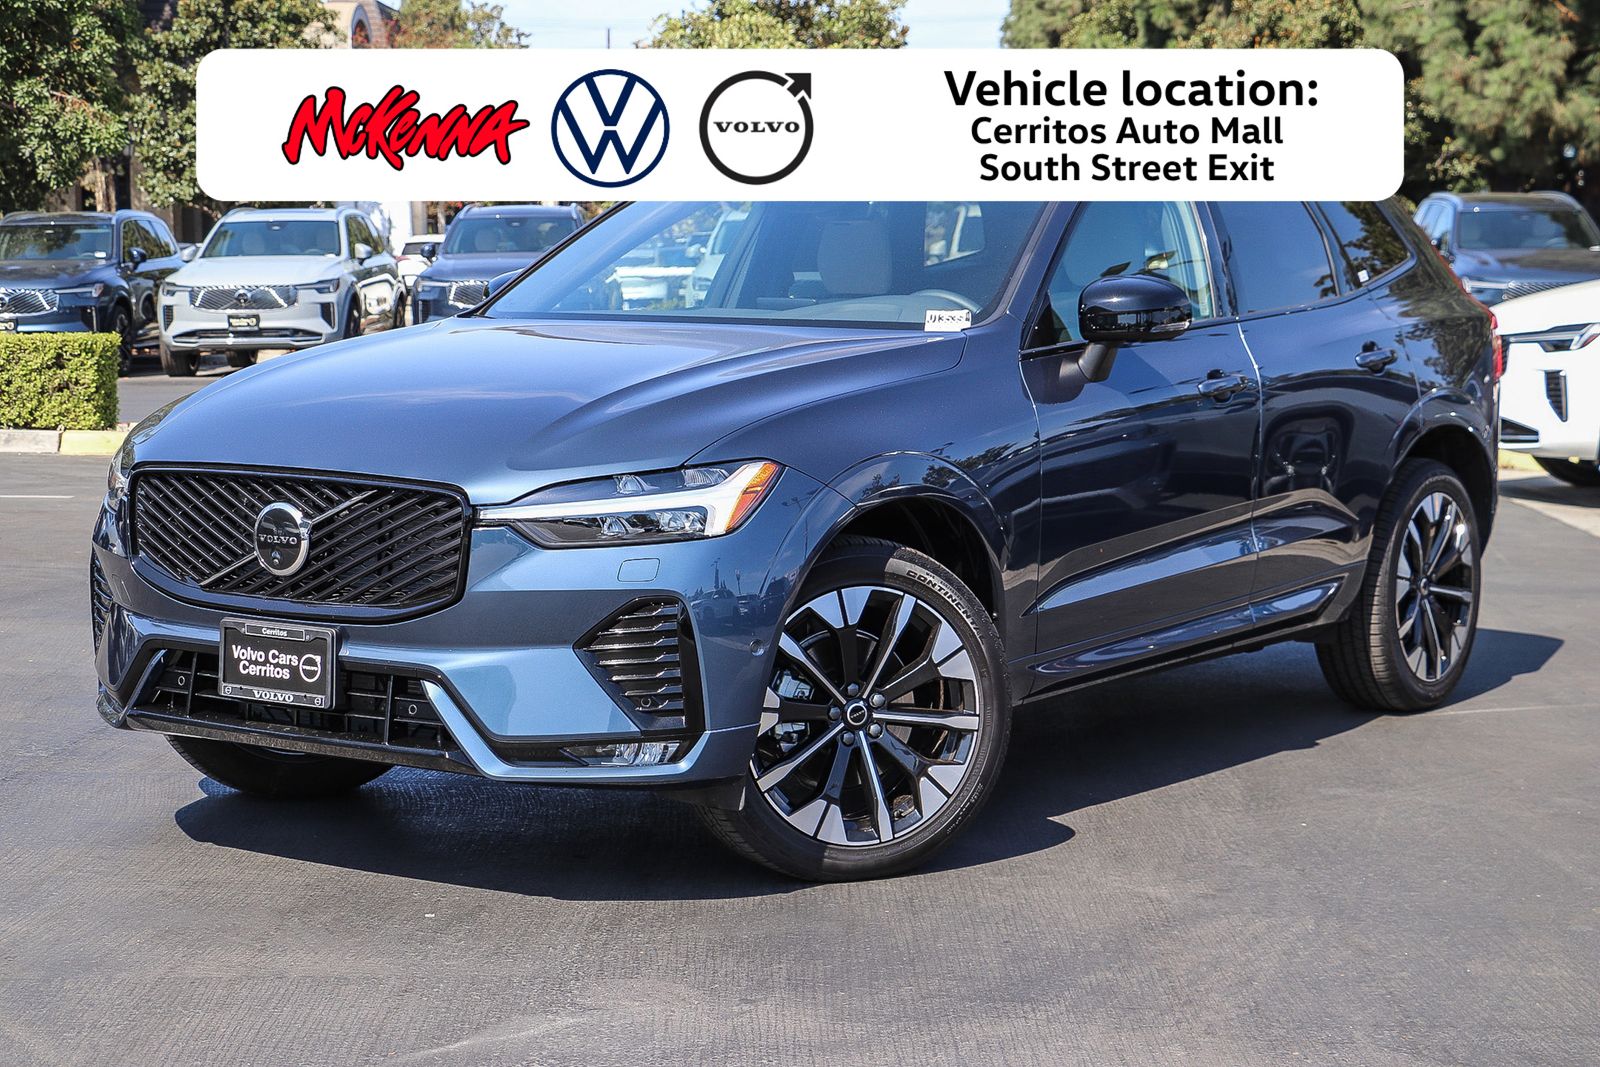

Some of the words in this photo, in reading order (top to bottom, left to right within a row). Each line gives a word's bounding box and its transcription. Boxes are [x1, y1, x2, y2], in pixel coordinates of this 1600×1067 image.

[258, 534, 297, 544] VOLVO
[262, 628, 288, 636] Cerritos
[232, 645, 264, 662] Volvo
[268, 649, 299, 666] Cars
[239, 661, 290, 679] Cerritos
[253, 689, 294, 702] VOLVO
